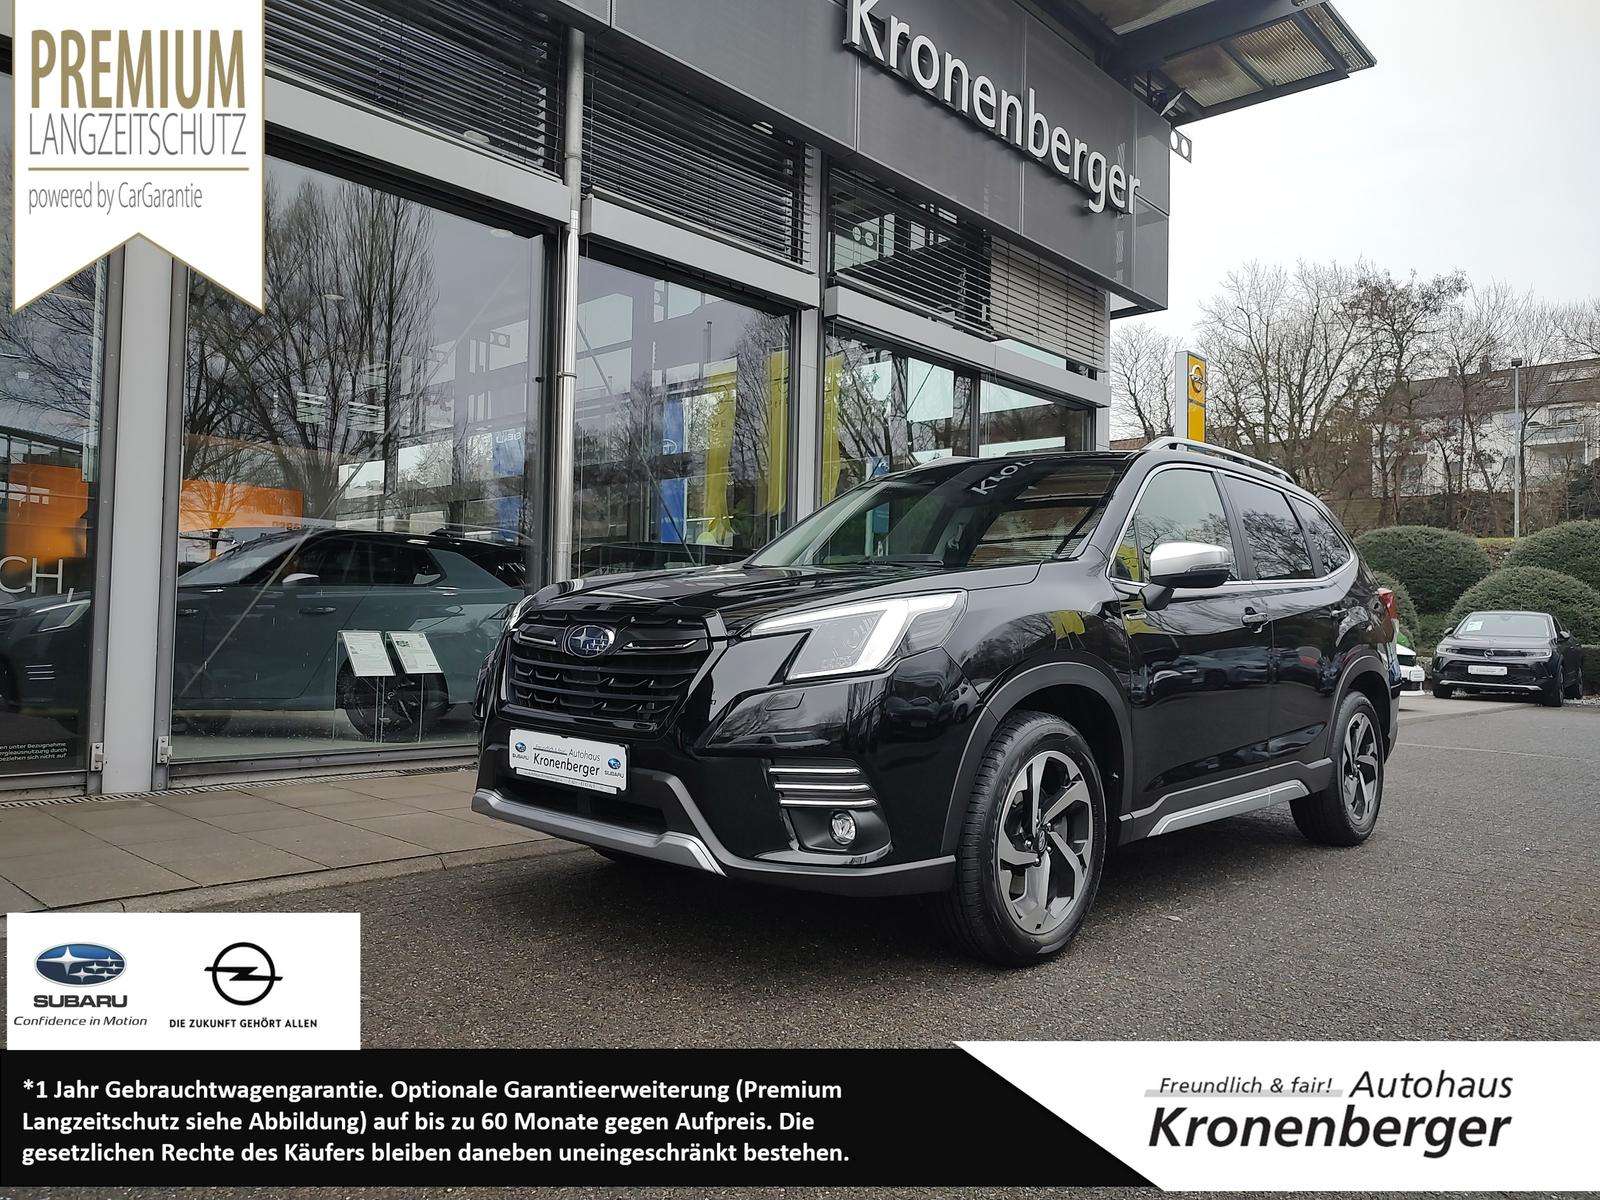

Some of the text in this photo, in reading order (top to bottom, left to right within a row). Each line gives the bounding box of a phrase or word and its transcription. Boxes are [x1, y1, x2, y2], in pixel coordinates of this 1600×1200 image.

[844, 0, 1140, 215] Kronenberger
[533, 753, 600, 777] Kronenberger
[568, 749, 601, 762] Autohaus
